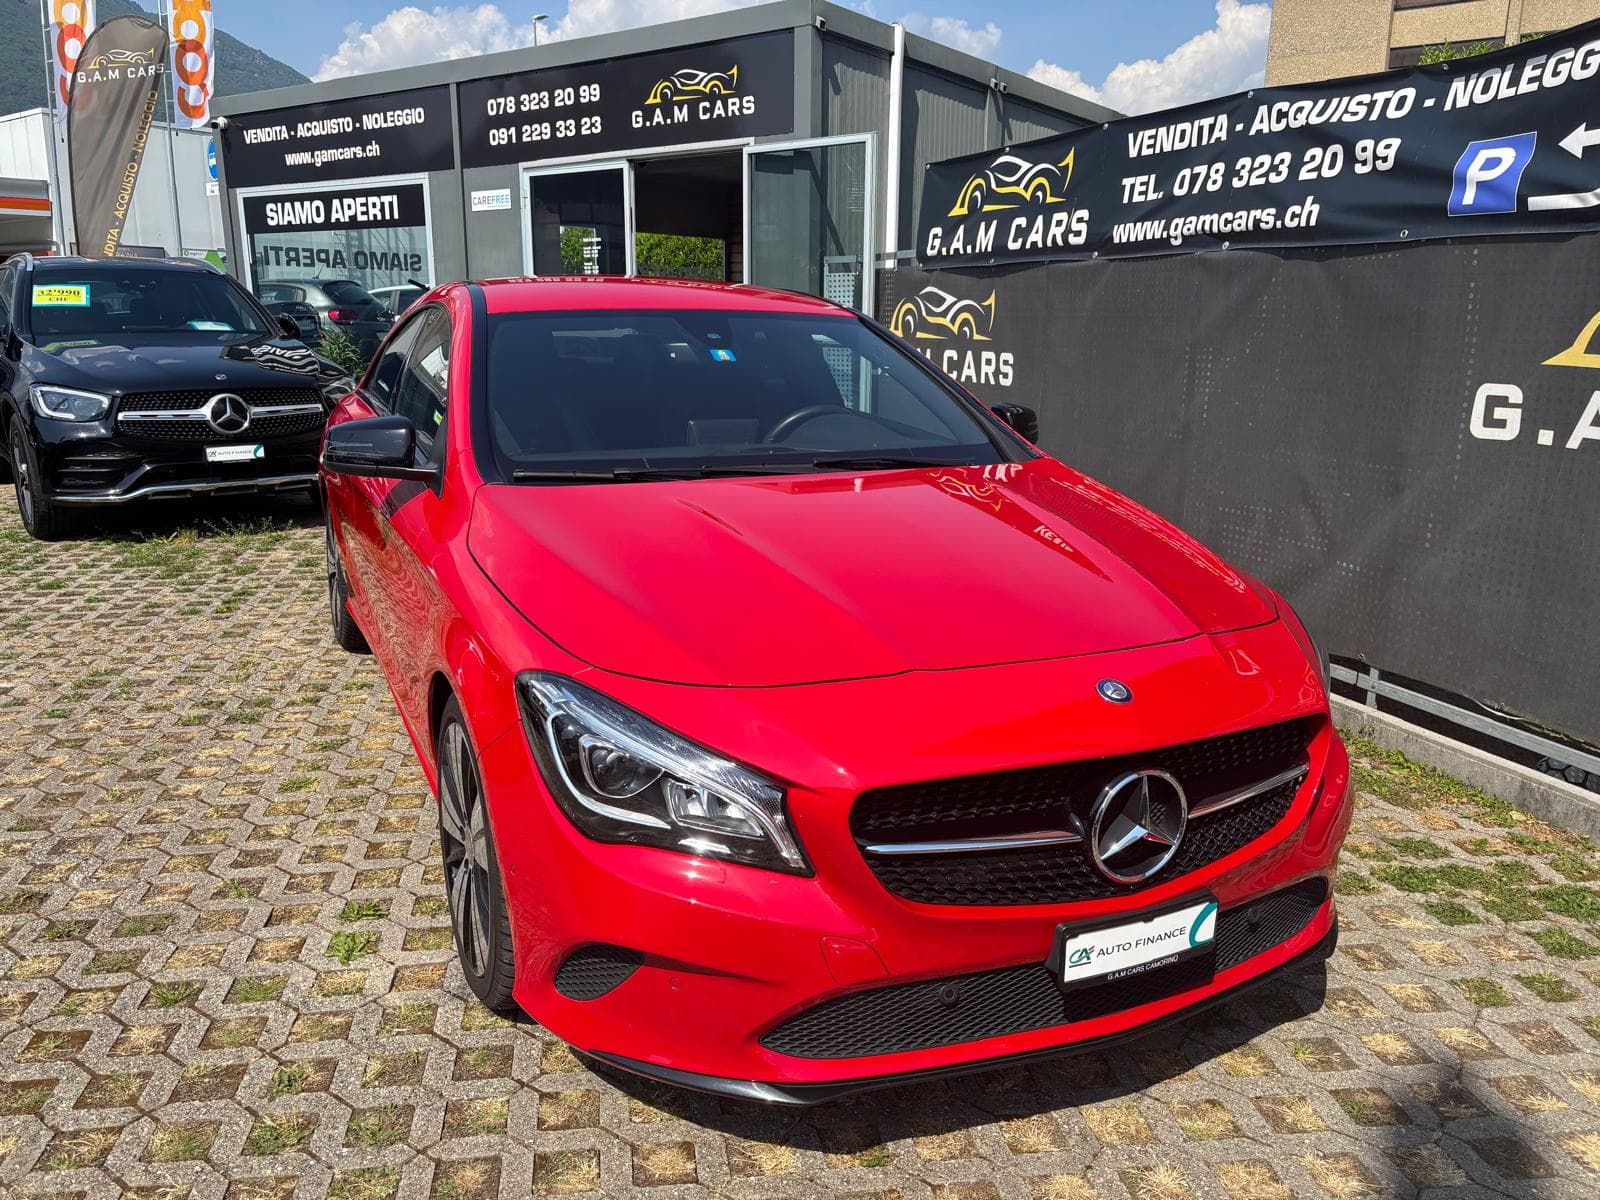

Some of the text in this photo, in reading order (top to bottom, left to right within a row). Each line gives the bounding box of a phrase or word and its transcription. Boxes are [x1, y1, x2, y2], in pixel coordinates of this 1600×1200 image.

[77, 63, 165, 83] G.A.M CARS
[487, 84, 600, 116] 078 323 20 99
[632, 95, 755, 129] G.A.M CARS
[243, 125, 289, 144] VENDITA
[297, 116, 353, 138] ACQUISTO
[362, 107, 425, 130] NOLEGGIO
[489, 115, 602, 146] 091 229 33 23
[1128, 114, 1228, 158] VENDITA
[1249, 88, 1416, 137] ACQUISTO
[114, 162, 139, 219] ACQUISTO
[131, 90, 158, 153] NOLEGGIO
[285, 140, 380, 167] www.gamcars.ch
[1121, 138, 1402, 204] TEL. 078 323 20 99
[1462, 147, 1516, 206] P
[266, 195, 399, 226] SIAMO APERTI
[472, 194, 510, 206] CAREFREE
[926, 209, 1090, 257] G.A.M CARS
[1113, 196, 1320, 246] www.gamcars.ch
[943, 349, 1014, 387] CARS
[1096, 942, 1132, 958] AUTO
[1135, 926, 1187, 948] FINANCE
[1127, 965, 1145, 976] CARS
[1145, 954, 1179, 970] CAMORINO
